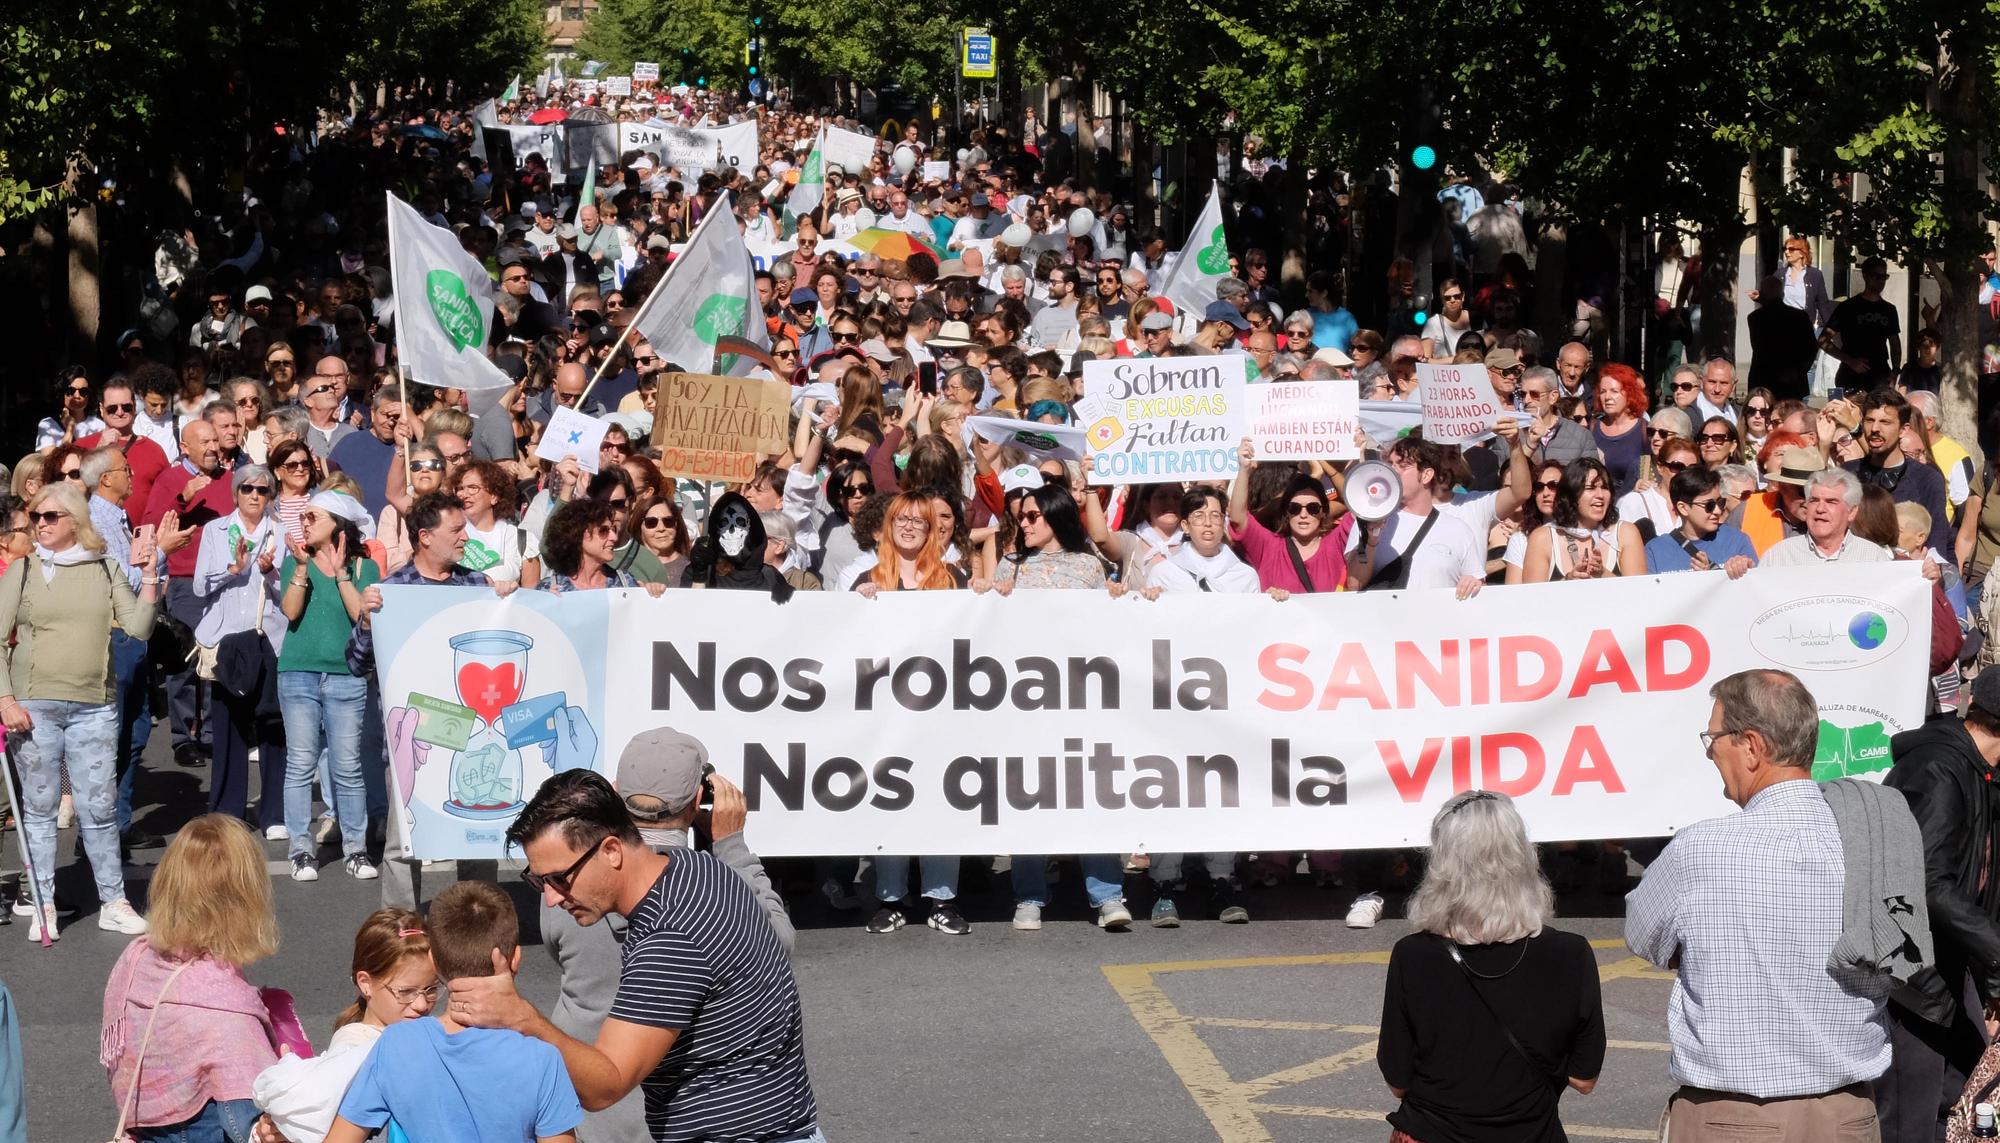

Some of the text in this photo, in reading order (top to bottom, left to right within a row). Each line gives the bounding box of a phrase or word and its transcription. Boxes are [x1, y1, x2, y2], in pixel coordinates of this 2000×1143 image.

[1106, 364, 1227, 400] Sobran
[1432, 369, 1461, 383] LLEVO
[670, 374, 749, 410] SOY LA
[1428, 387, 1477, 401] 23 HORAS
[1125, 393, 1228, 421] EXCUSAS
[1125, 419, 1231, 454] Faltan
[1312, 418, 1352, 435] ESTÁN
[1446, 420, 1487, 437] CURO?
[1264, 439, 1340, 454] CURANDO!
[1094, 446, 1239, 478] CONTRATOS
[1756, 612, 1774, 626] MESA
[1773, 608, 1784, 617] EN
[1784, 599, 1815, 612] DEFENSA
[1827, 597, 1836, 605] LA
[1836, 597, 1866, 606] SANIDAD
[651, 623, 1711, 713] Nos roban la SANIDAD
[506, 707, 534, 724] VISA
[1846, 704, 1858, 712] DE
[1858, 706, 1889, 721] MAREAS
[1859, 746, 1889, 758] CAMB
[743, 725, 1627, 826] Nos quitan la VIDA
